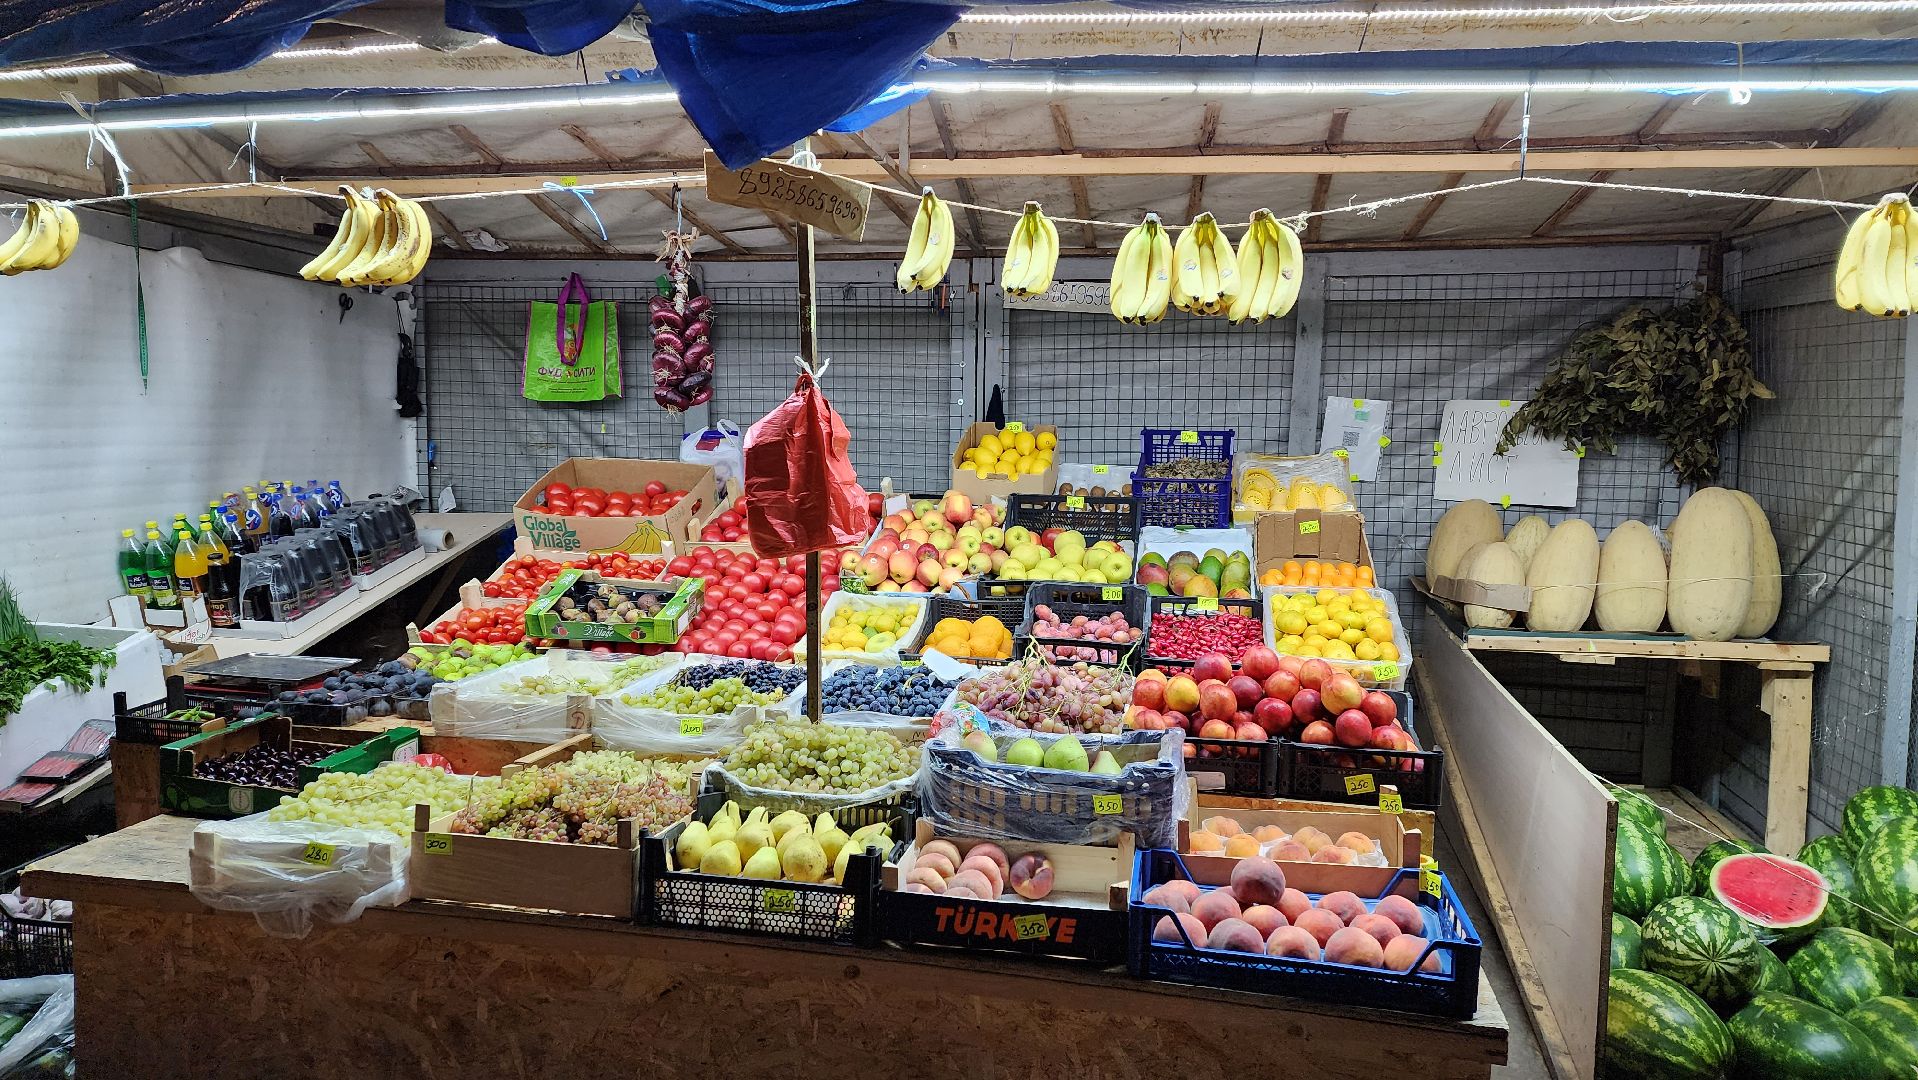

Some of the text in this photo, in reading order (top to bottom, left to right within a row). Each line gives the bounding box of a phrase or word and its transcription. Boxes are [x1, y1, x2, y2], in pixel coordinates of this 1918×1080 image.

[1449, 450, 1519, 484] ЛИСТ
[523, 516, 567, 532] Global
[529, 531, 581, 551] Village
[1350, 780, 1369, 791] 250
[1097, 801, 1119, 811] 350
[1382, 799, 1400, 811] 350
[426, 839, 447, 849] 300
[305, 846, 328, 861] 280
[1020, 922, 1045, 936] 350
